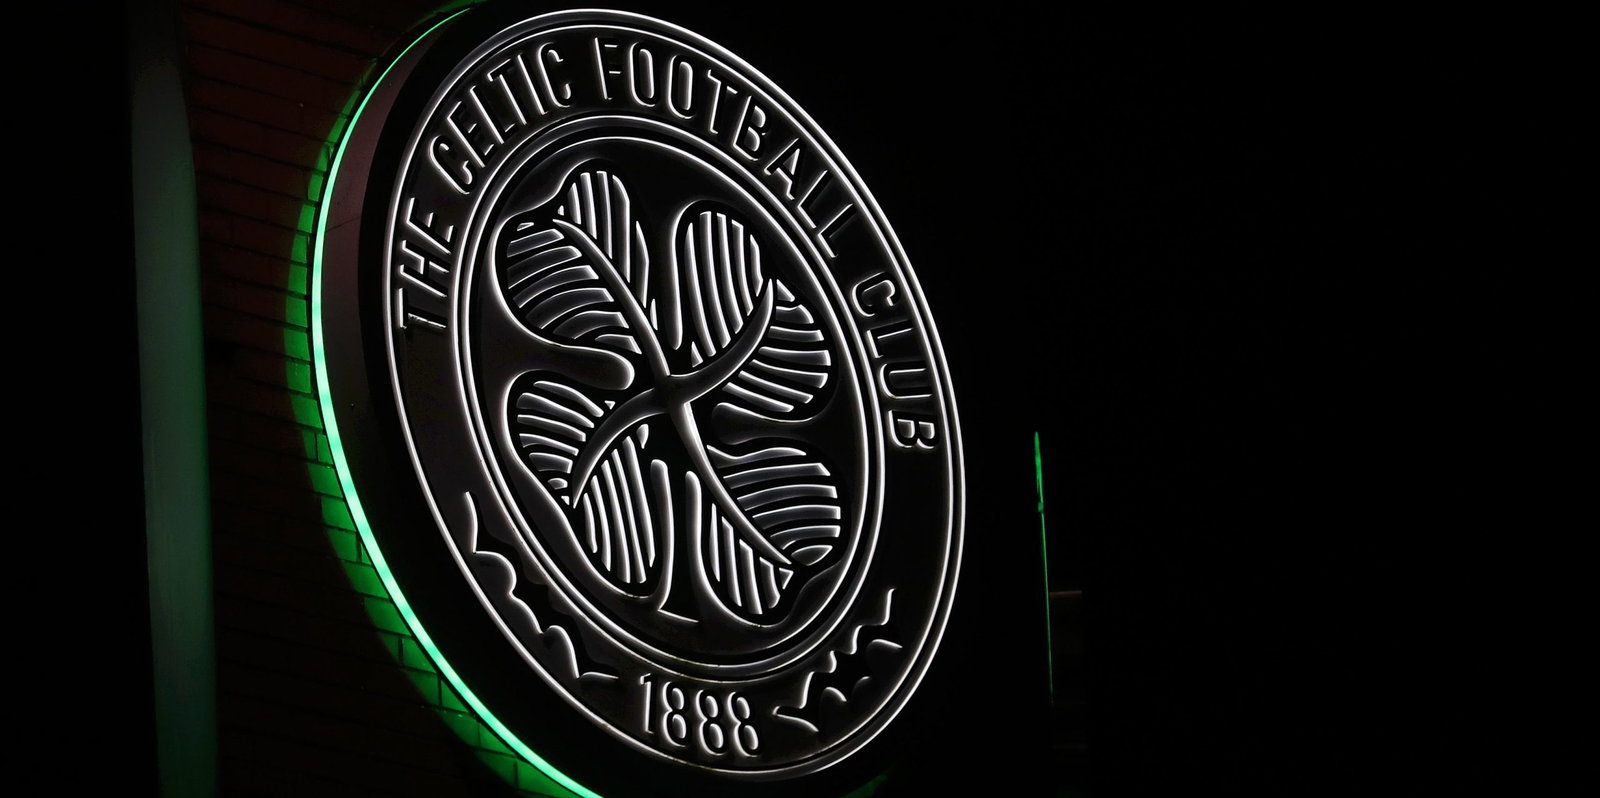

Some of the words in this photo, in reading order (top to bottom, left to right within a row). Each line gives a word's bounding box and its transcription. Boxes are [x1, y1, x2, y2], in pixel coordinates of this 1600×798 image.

[397, 196, 458, 330] THE
[430, 41, 576, 195] CELTIC
[594, 37, 858, 259] FOOTBALL
[851, 271, 940, 450] CLUB
[640, 672, 762, 757] 1888
